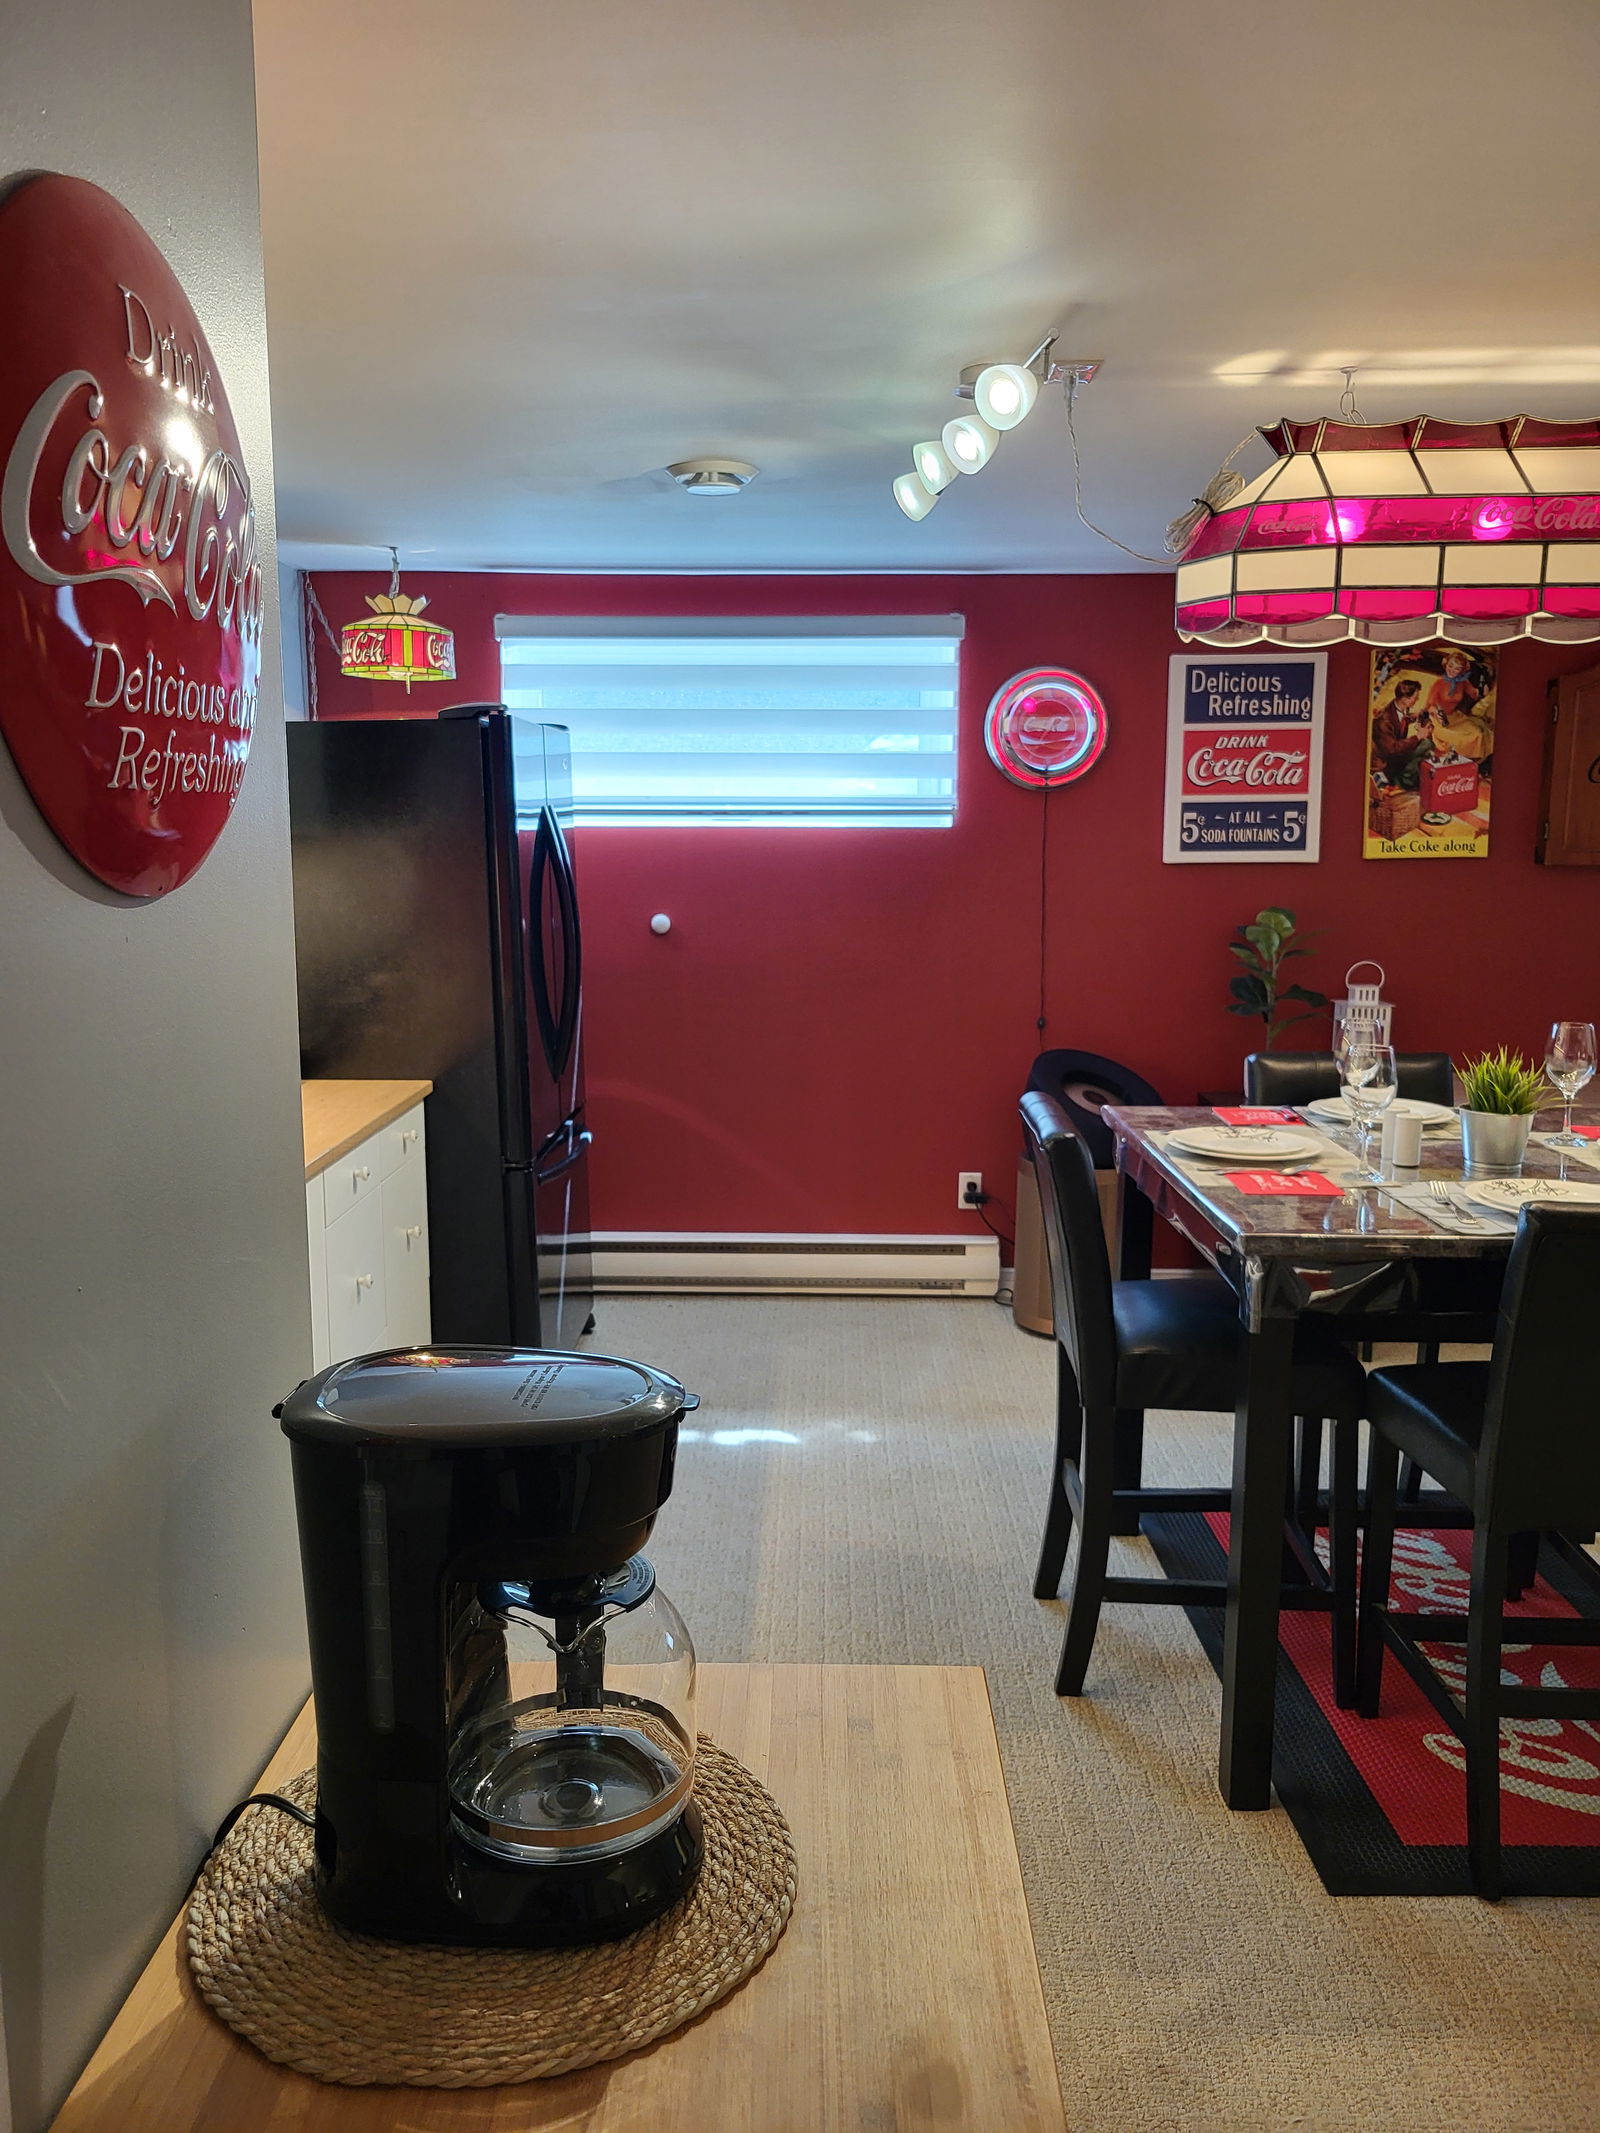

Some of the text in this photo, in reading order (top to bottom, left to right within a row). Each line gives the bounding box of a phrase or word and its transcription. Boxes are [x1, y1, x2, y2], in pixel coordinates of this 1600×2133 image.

[117, 284, 216, 415] Drink
[84, 641, 225, 726] Delicious
[1191, 669, 1282, 694] Delicious
[1208, 694, 1311, 720] Refreshing
[1215, 735, 1269, 749] DRINK
[107, 726, 248, 807] Refreshing
[1228, 811, 1262, 824] AT ALL
[1201, 828, 1280, 843] SODA FOUNTAINS
[1378, 840, 1476, 854] Take Coke along
